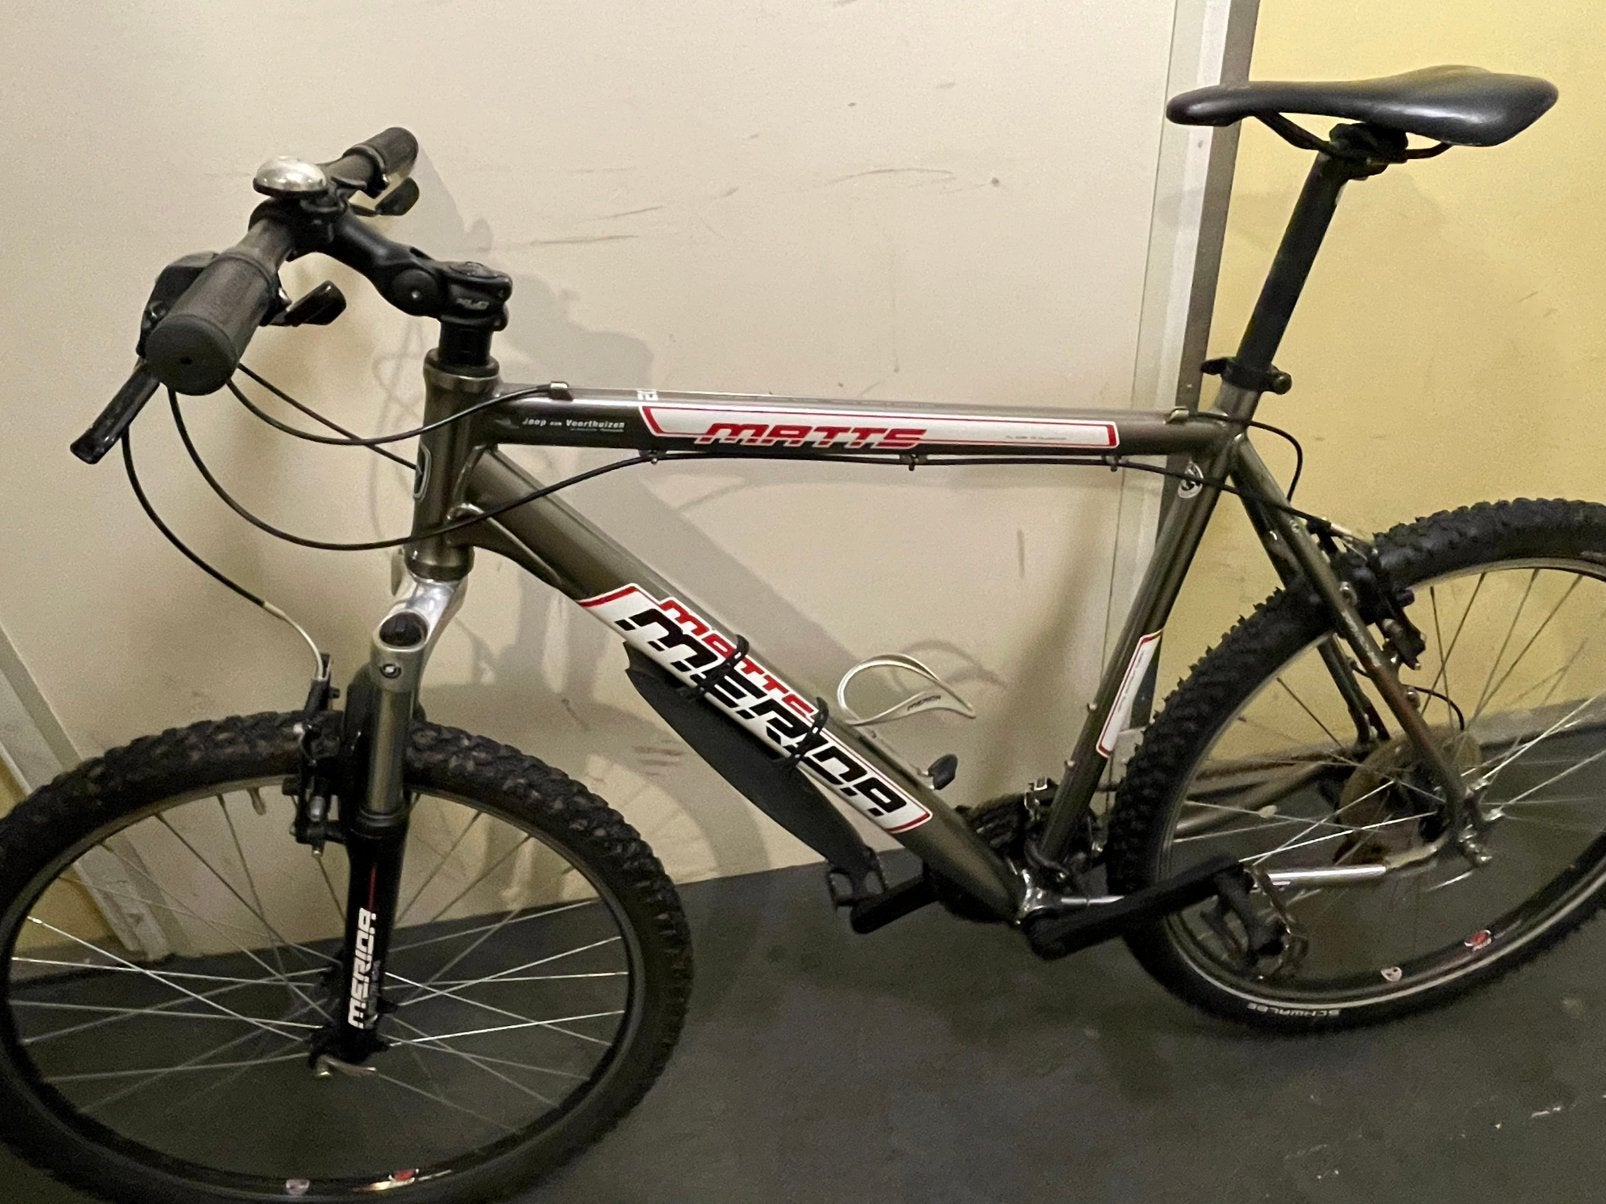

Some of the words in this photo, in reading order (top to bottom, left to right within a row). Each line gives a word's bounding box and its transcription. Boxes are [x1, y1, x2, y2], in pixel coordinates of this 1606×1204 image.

[694, 422, 928, 450] MATTS
[659, 599, 816, 719] MATTS
[348, 907, 377, 1029] MERIDA
